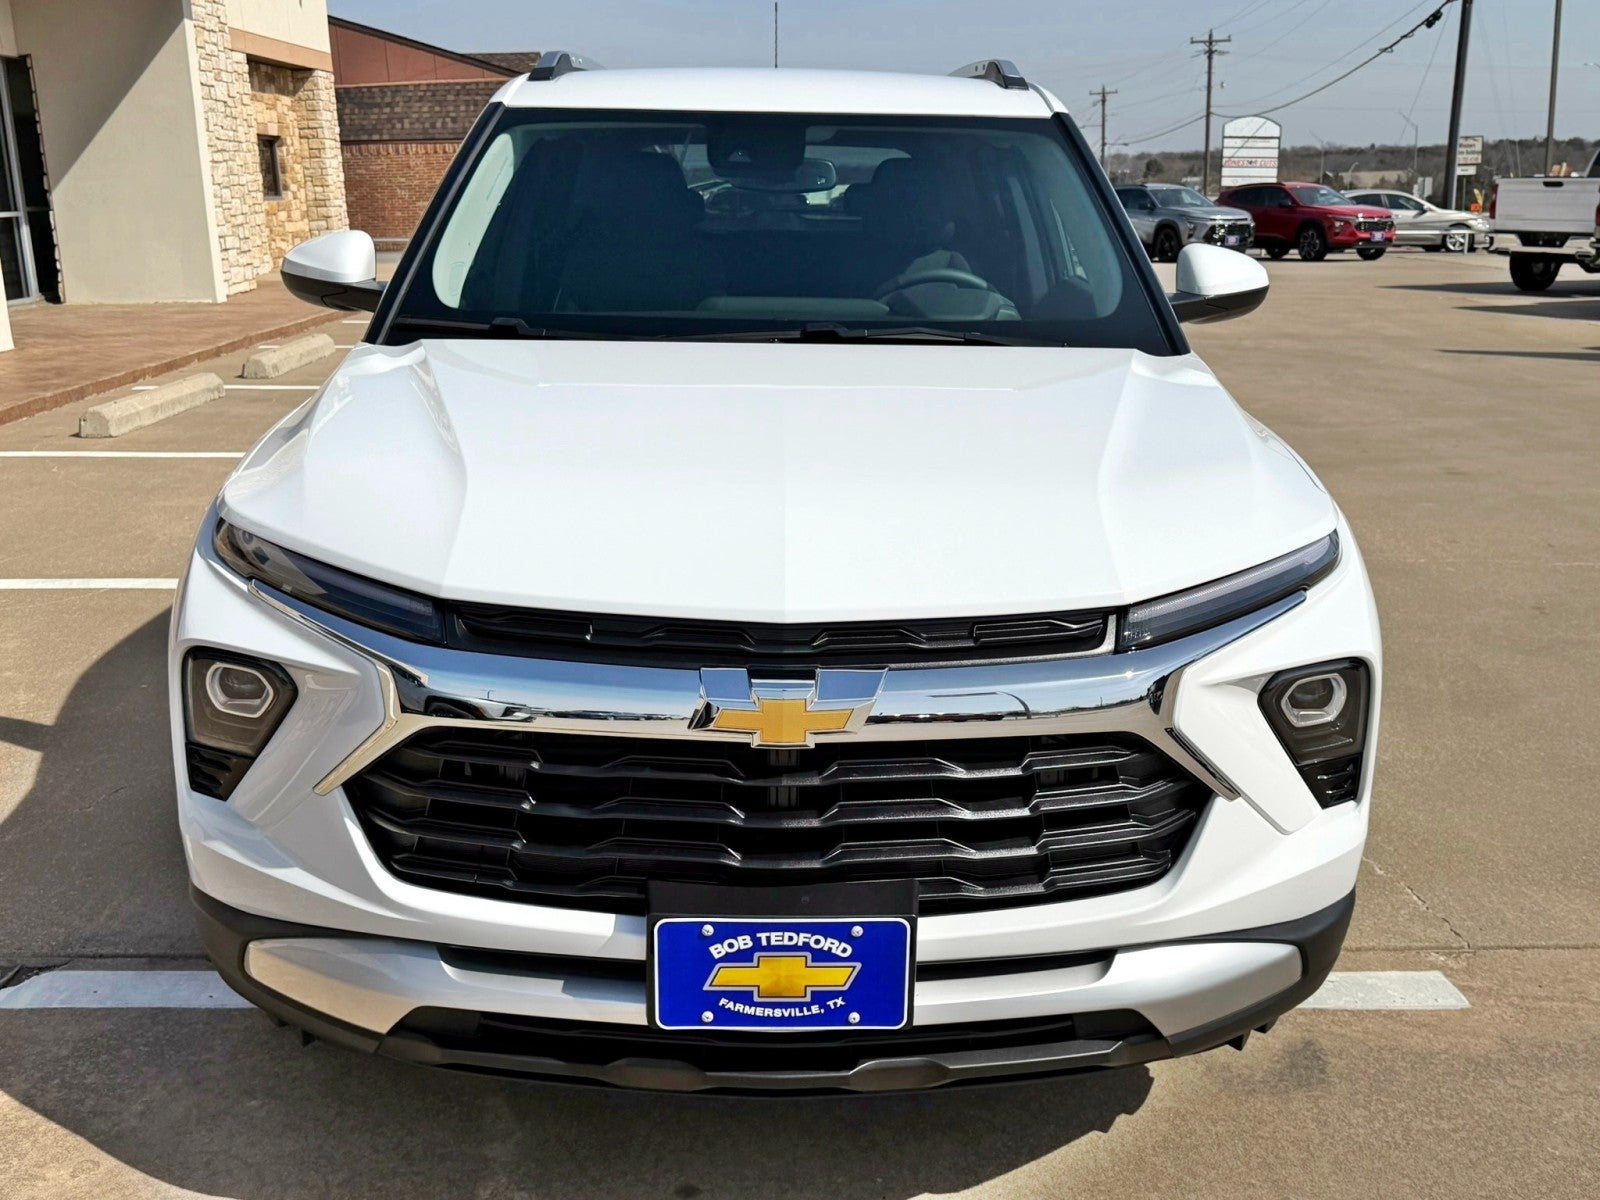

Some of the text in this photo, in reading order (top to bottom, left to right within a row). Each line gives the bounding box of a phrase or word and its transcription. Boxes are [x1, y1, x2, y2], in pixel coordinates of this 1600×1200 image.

[708, 931, 853, 960] BOB TEDFORD
[718, 996, 846, 1018] FARMERSVILLE, TX
